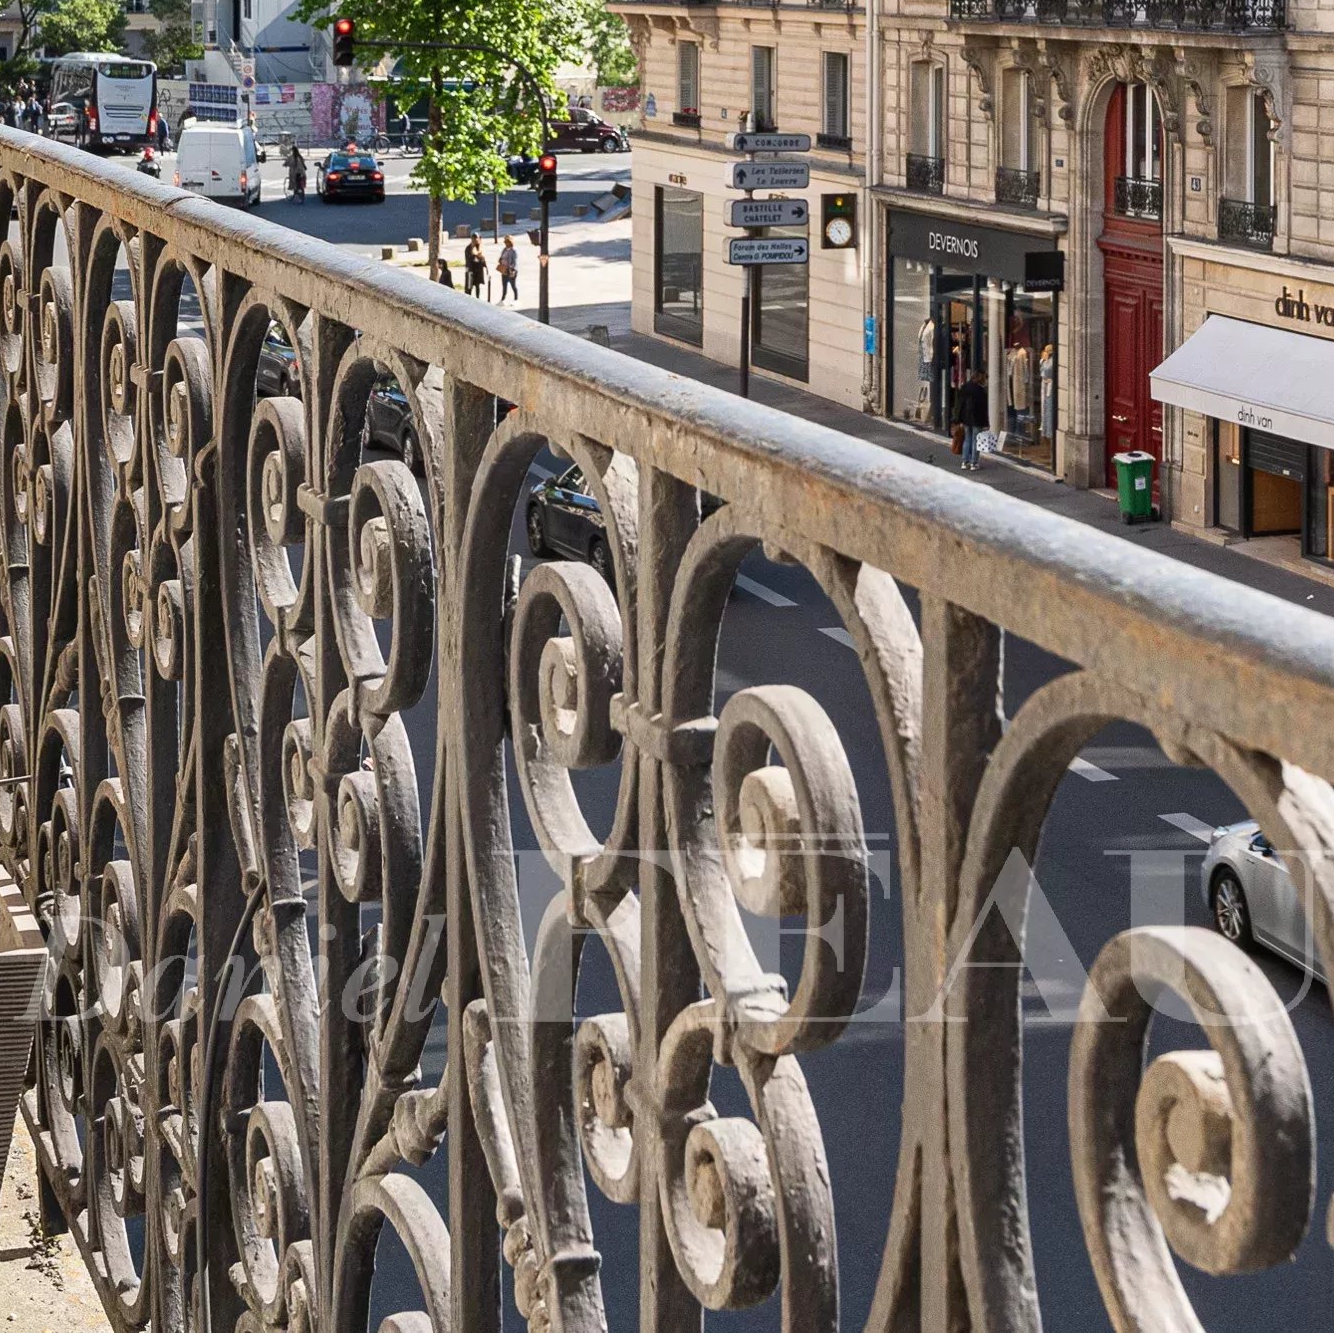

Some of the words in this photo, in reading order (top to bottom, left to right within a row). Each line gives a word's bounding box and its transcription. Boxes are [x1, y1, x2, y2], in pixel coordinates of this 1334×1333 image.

[755, 139, 800, 147] CONCORDE
[751, 167, 766, 175] Les
[769, 167, 805, 175] Tuileries
[770, 177, 798, 185] Louvre
[743, 204, 783, 213] BASTILLE
[744, 213, 782, 223] CHÂTELET
[733, 243, 756, 251] Forum
[757, 242, 769, 250] des
[929, 231, 979, 259] DEVERNOIS
[733, 252, 753, 261] Centre
[761, 252, 794, 261] POMPIDOU
[1275, 286, 1310, 322] dinh
[1238, 405, 1255, 424] dinh
[1257, 415, 1273, 430] van
